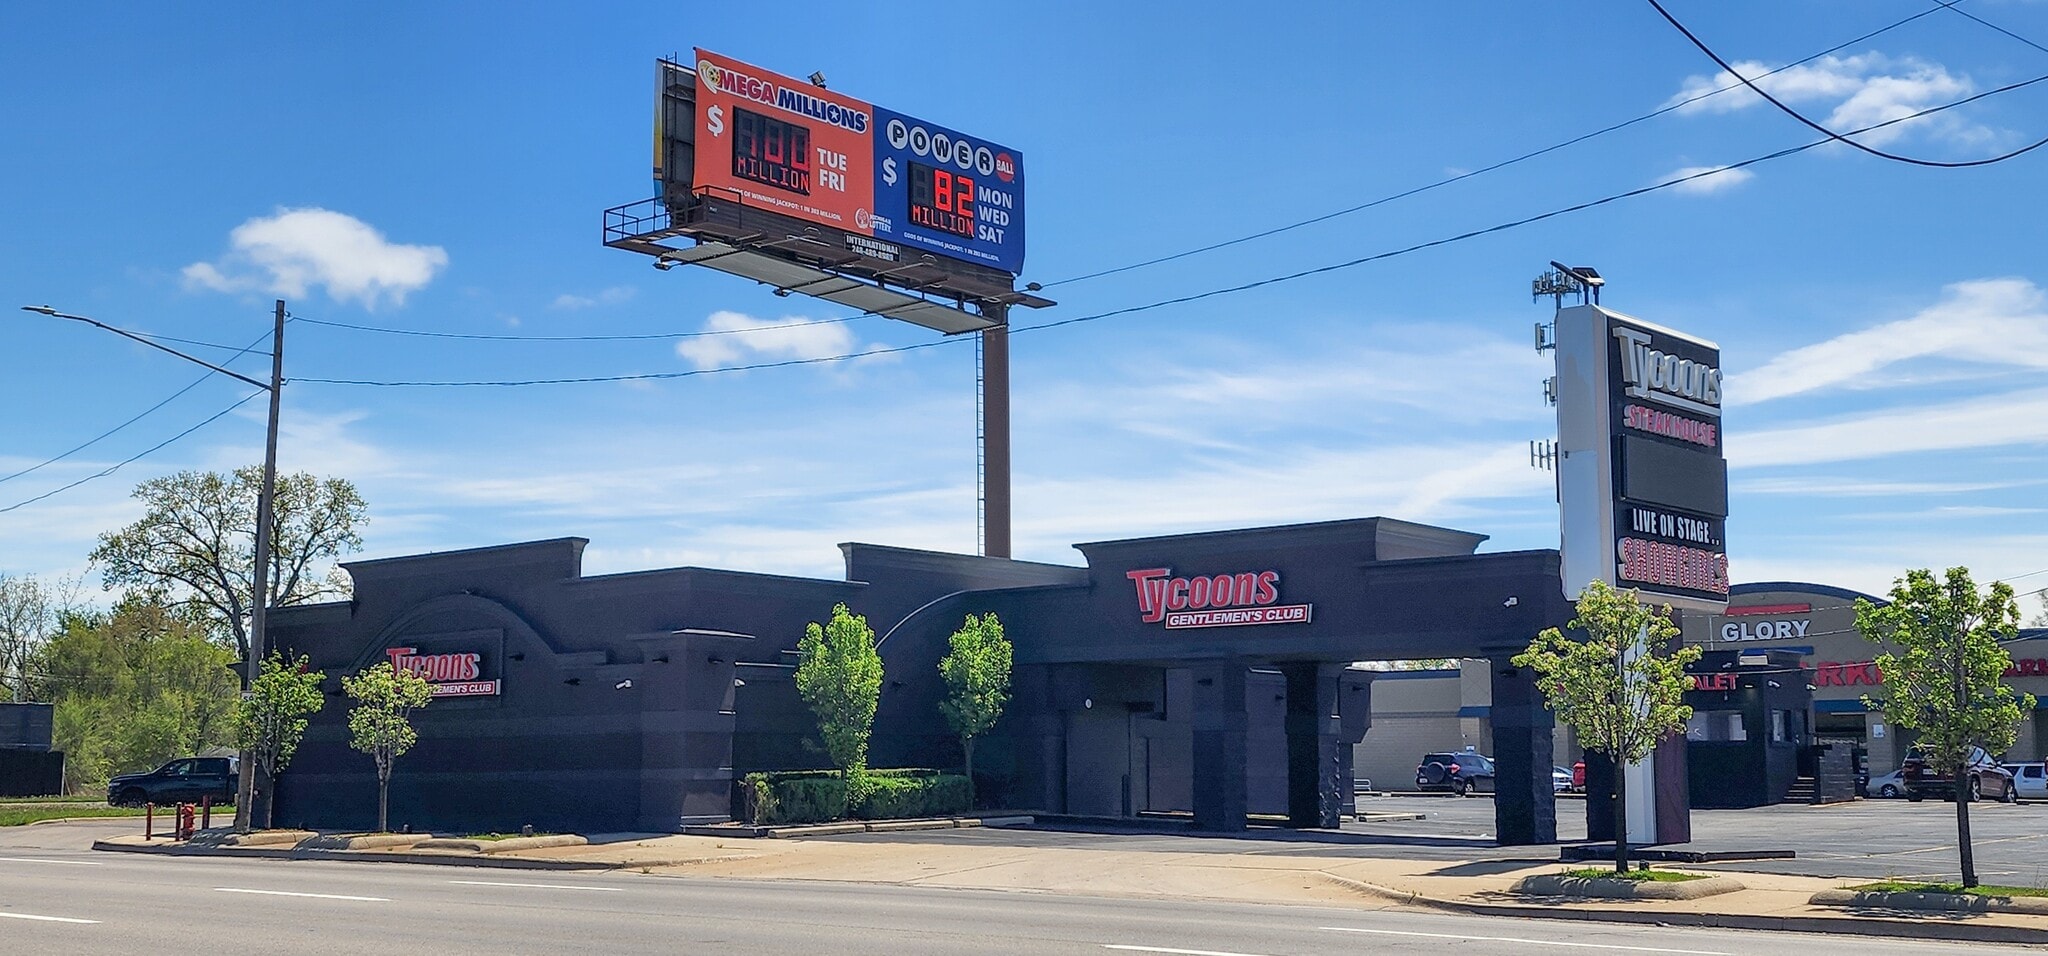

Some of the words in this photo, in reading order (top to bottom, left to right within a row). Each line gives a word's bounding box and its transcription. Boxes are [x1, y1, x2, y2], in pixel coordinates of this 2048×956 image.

[719, 68, 776, 105] MEGA
[777, 88, 867, 132] MILLIONS
[707, 105, 724, 137] $
[816, 147, 847, 172] TUE
[890, 121, 992, 174] POWER
[996, 159, 1015, 175] BALL
[737, 156, 810, 193] MILLION
[819, 168, 845, 192] FRI
[882, 156, 898, 187] $
[934, 169, 974, 218] 82
[978, 185, 1013, 209] MON
[911, 204, 974, 237] MILLION
[978, 204, 1010, 227] WED
[846, 234, 899, 255] INTERNATIONAL
[978, 224, 1005, 245] SAT
[1613, 326, 1724, 405] Tycoons
[1624, 404, 1717, 448] STEAKHOUSE
[1633, 508, 1657, 534] LIVE
[1660, 514, 1675, 538] ON
[1618, 536, 1729, 595] SHOWGIRLS
[1126, 568, 1280, 623] Tycoons
[1169, 608, 1263, 627] GENTLEMEN'S
[1265, 606, 1305, 620] CLUB
[1721, 619, 1810, 642] GLORY
[469, 683, 492, 693] CLUB
[1694, 672, 1739, 691] ALET
